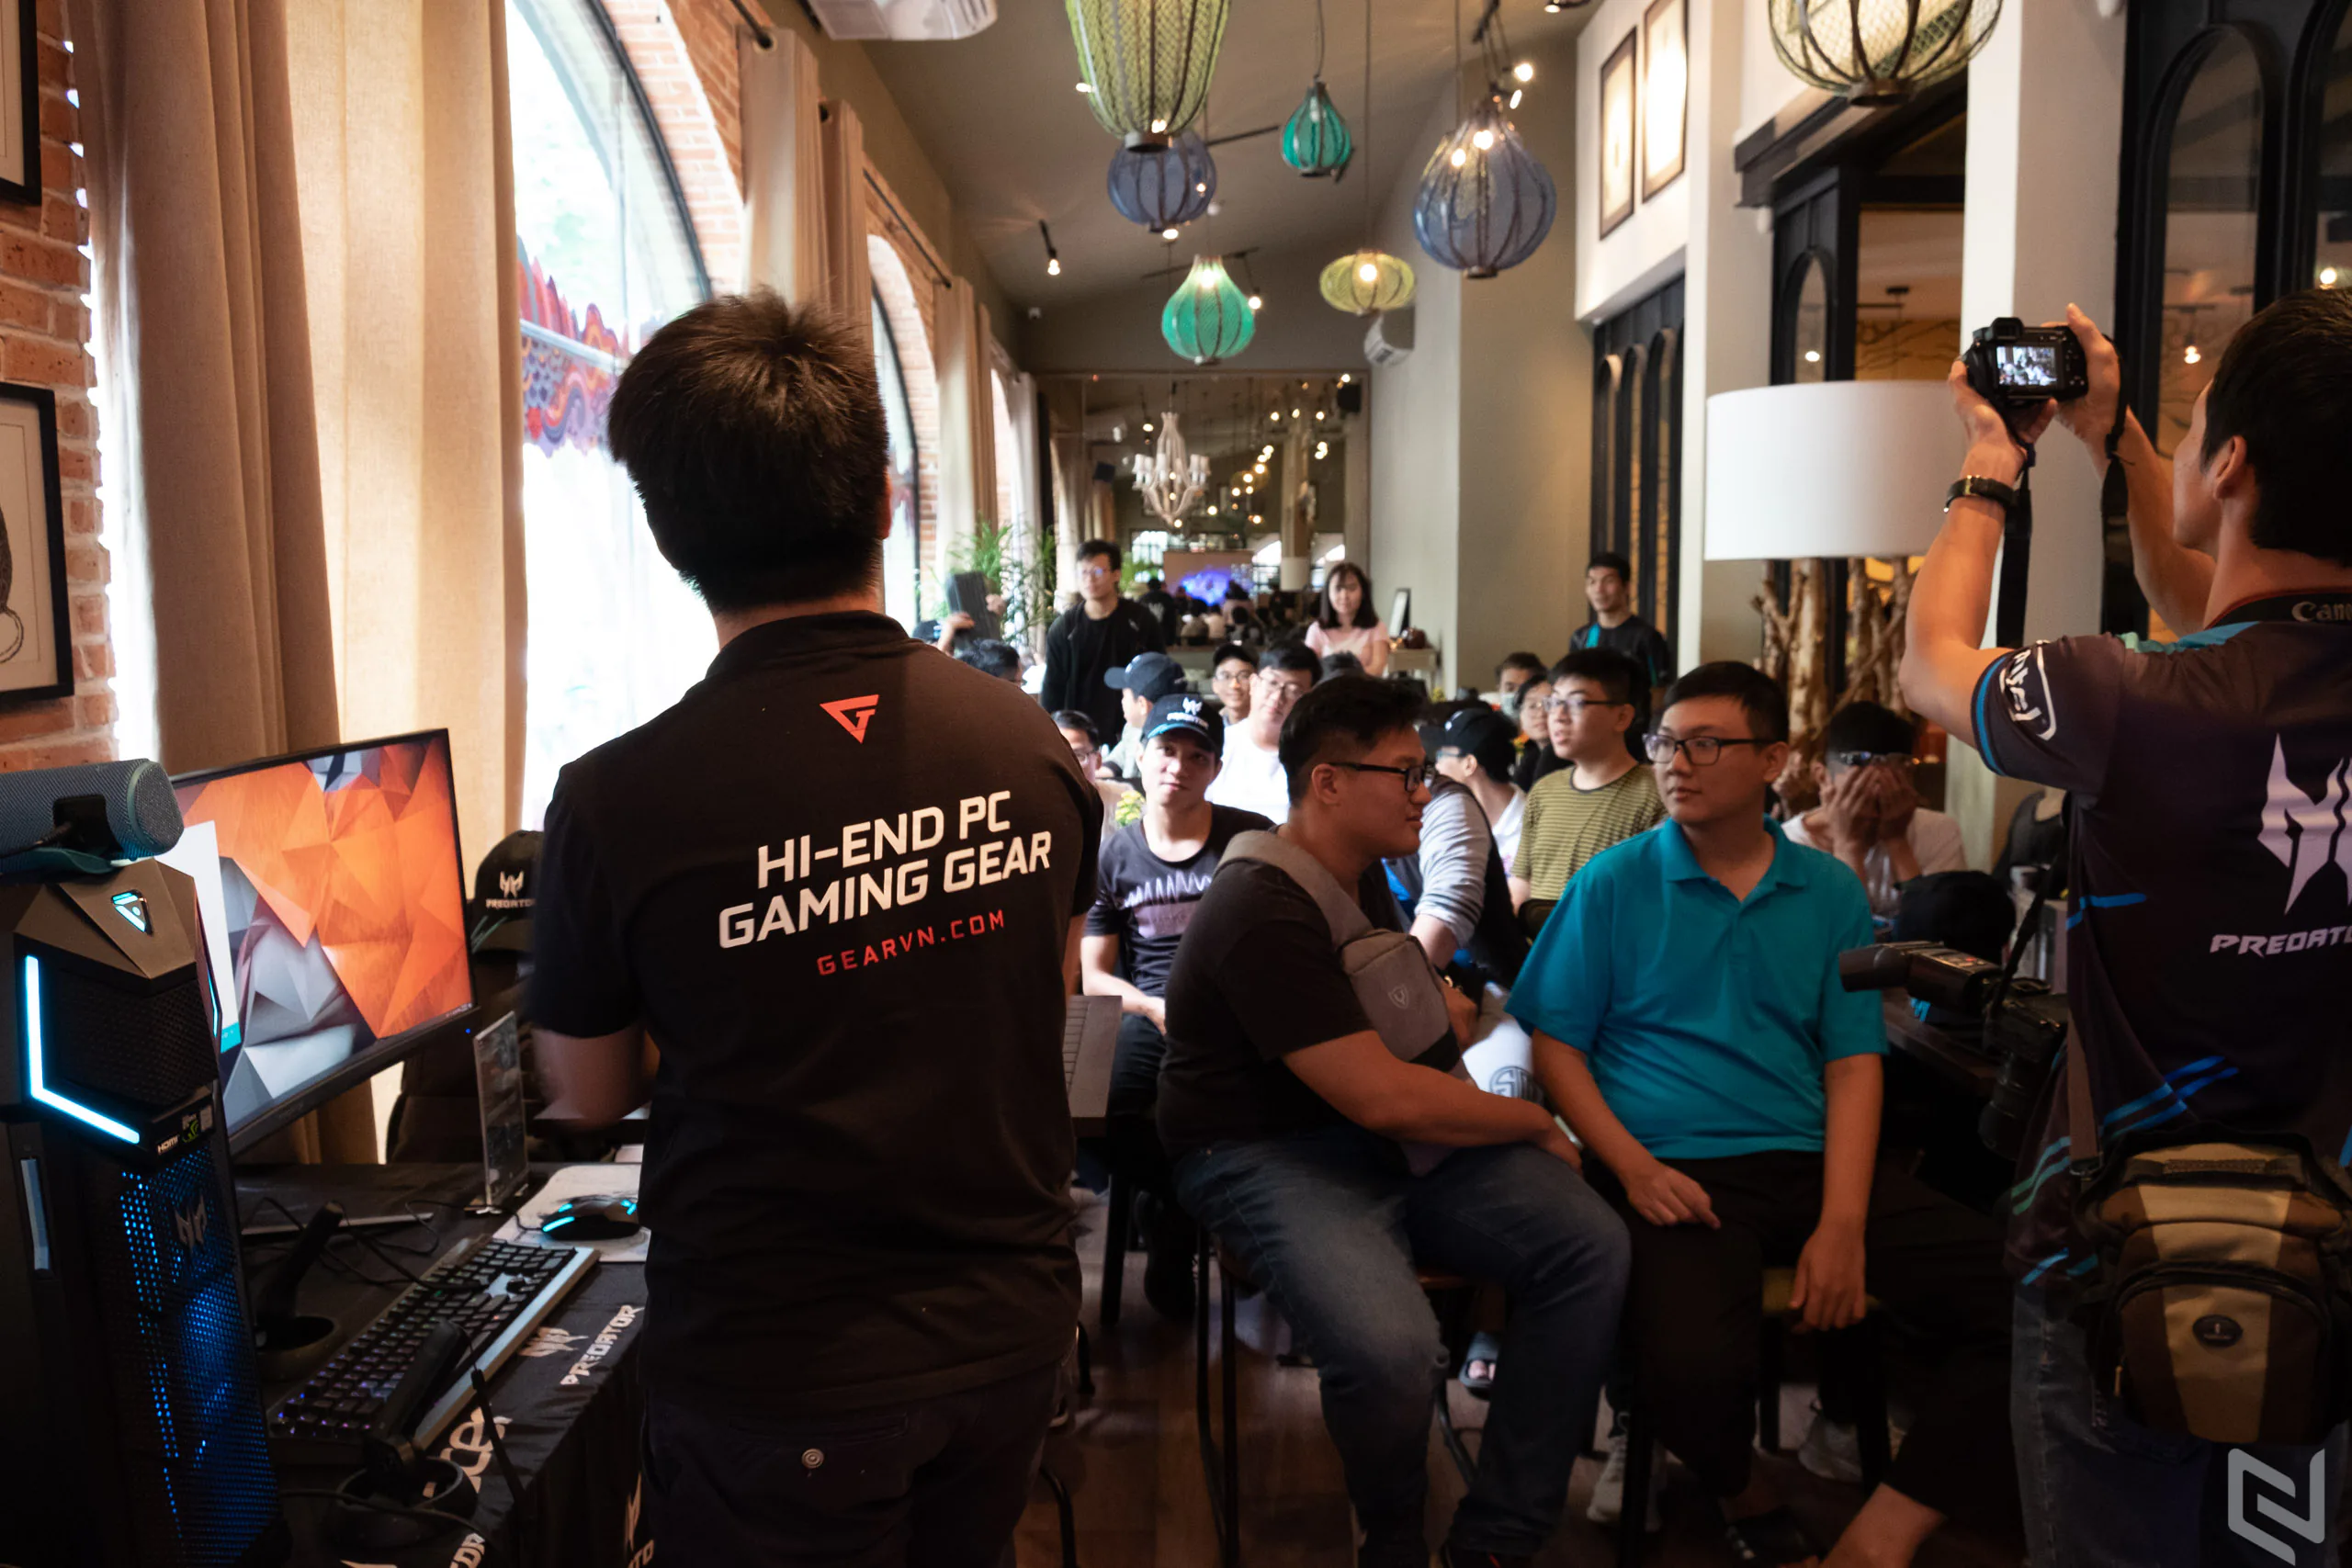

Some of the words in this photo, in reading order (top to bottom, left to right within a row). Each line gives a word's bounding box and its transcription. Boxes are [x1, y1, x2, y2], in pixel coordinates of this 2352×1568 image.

[758, 806, 944, 888] HI-END
[959, 790, 1011, 840] PC
[718, 858, 929, 949] GAMING
[943, 830, 1052, 894] GEAR
[817, 908, 1005, 976] GEARVN.COM
[560, 1304, 645, 1385] PREDATOR
